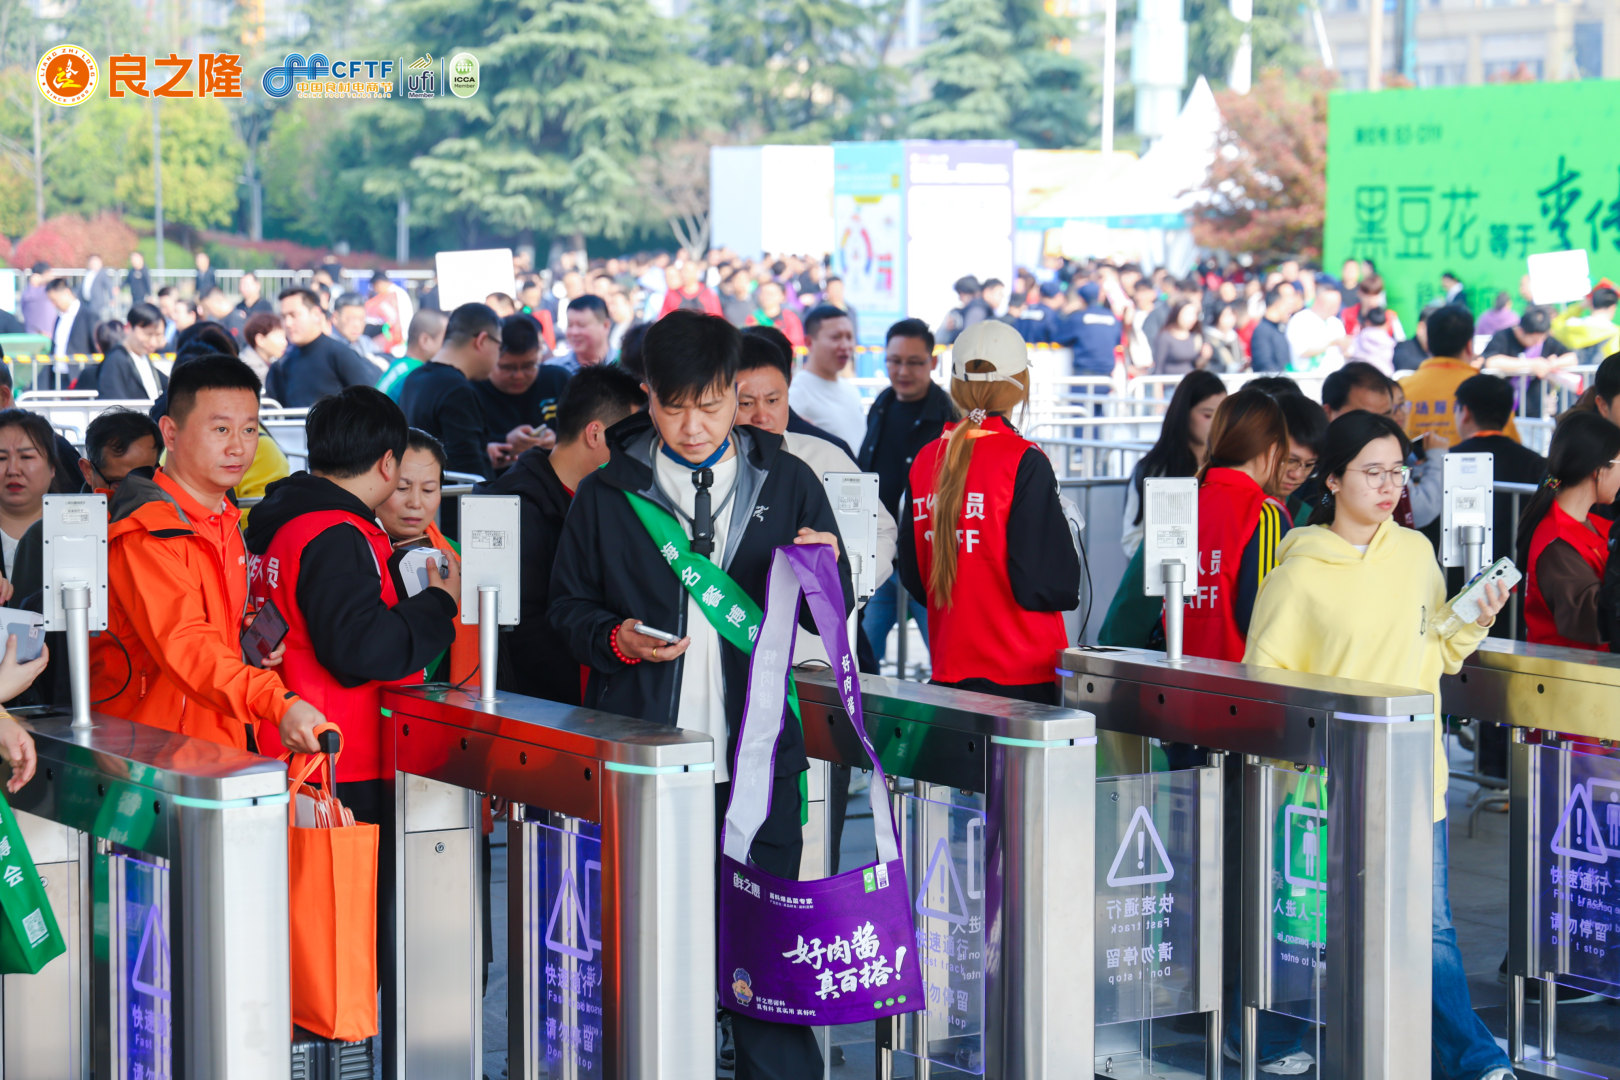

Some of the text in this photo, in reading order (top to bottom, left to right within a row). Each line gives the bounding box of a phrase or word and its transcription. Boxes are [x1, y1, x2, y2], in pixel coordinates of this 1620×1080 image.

[913, 492, 985, 521] 工员
[841, 653, 855, 716] 好肉酱
[782, 921, 880, 970] 好肉酱
[1584, 945, 1605, 958] stop
